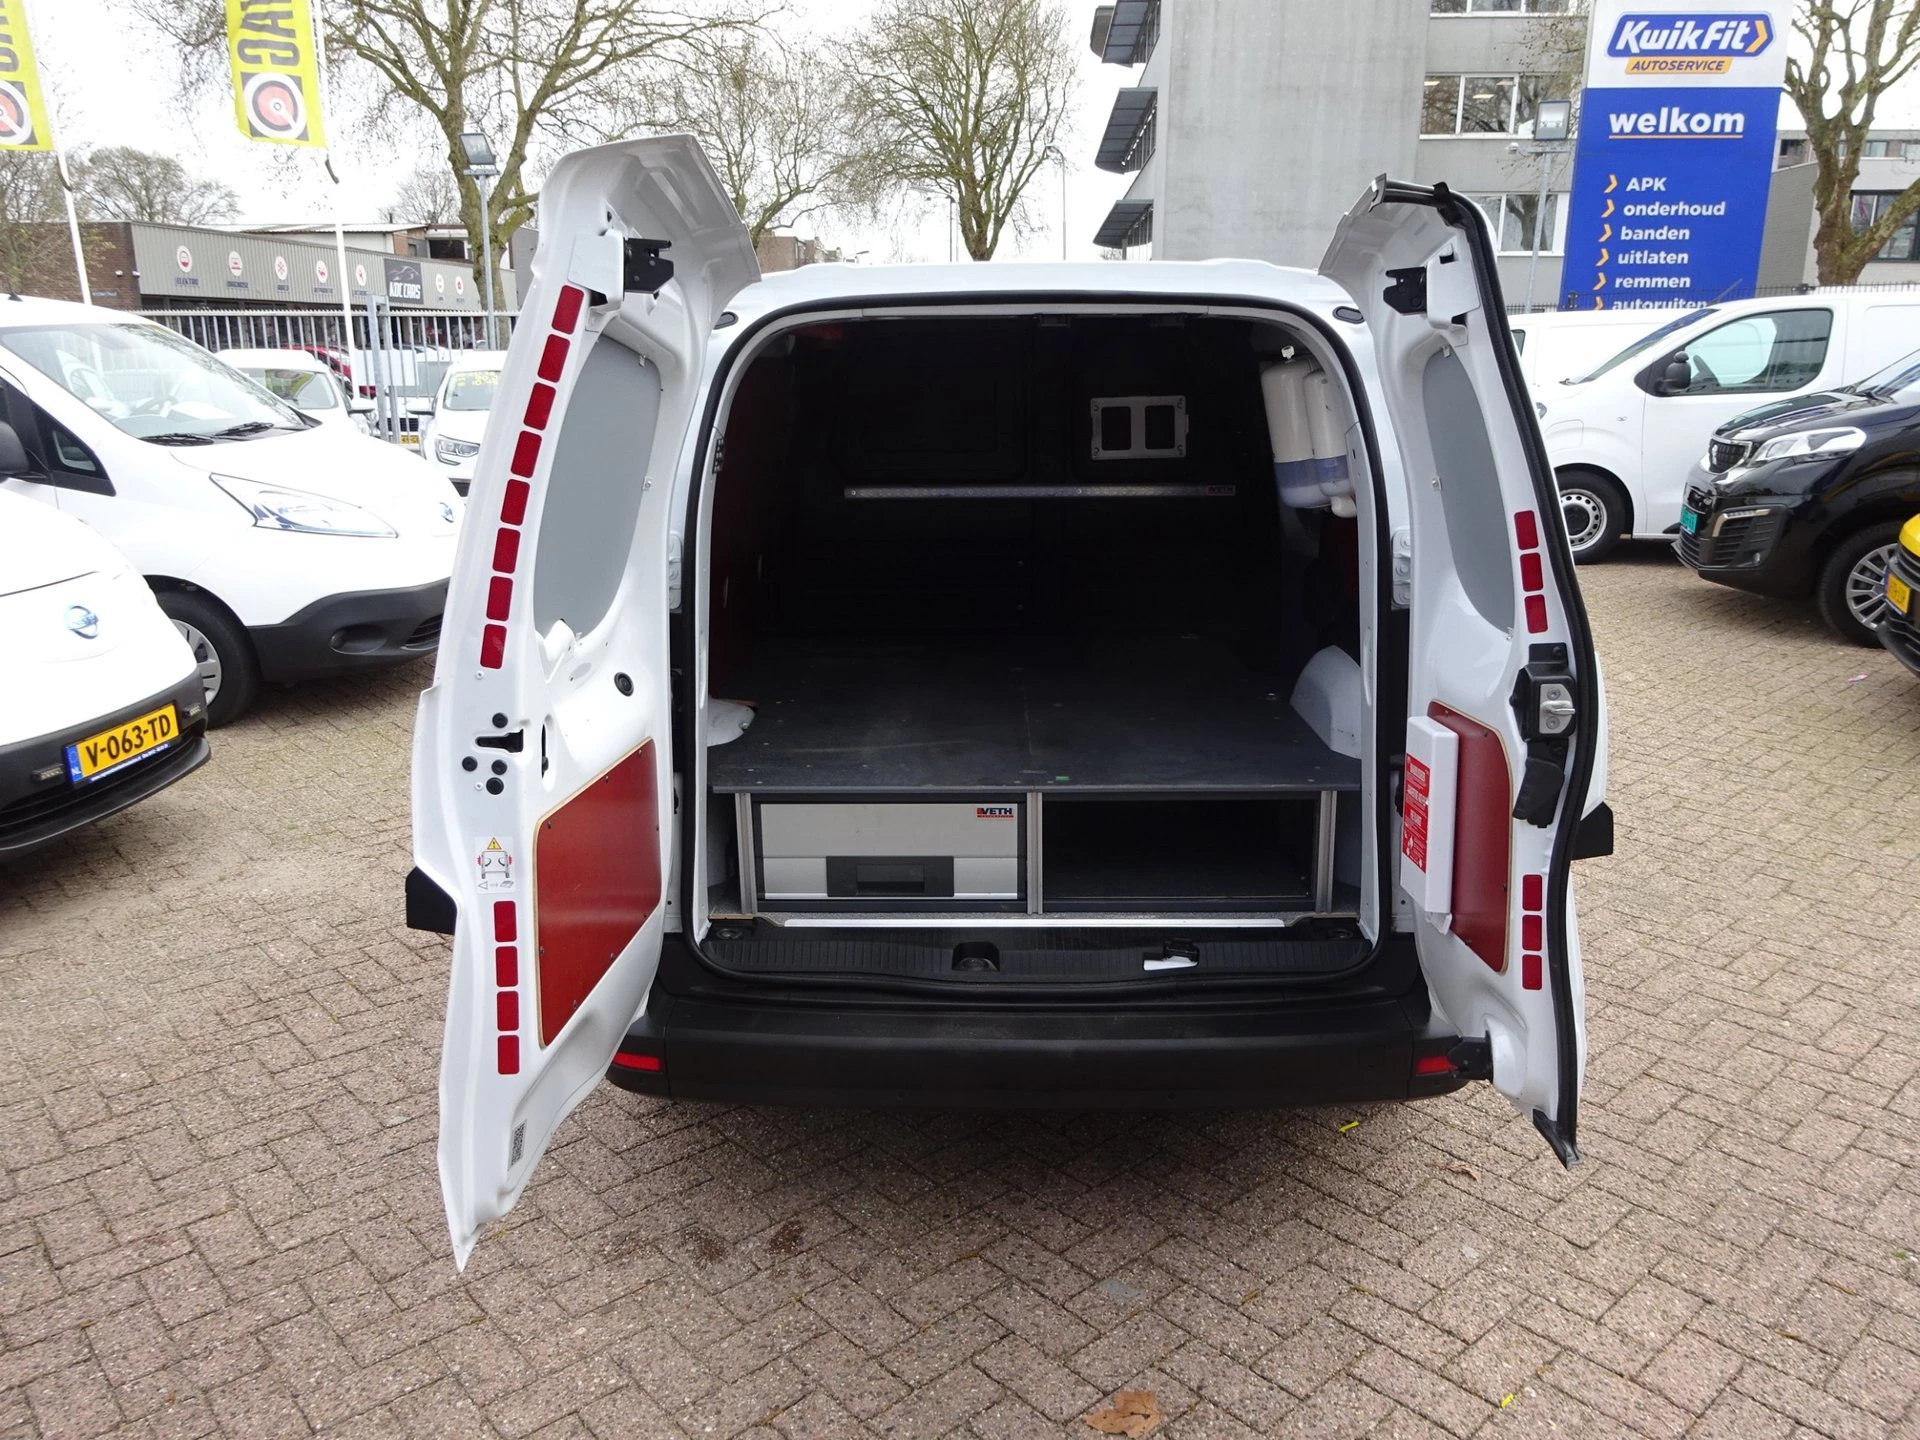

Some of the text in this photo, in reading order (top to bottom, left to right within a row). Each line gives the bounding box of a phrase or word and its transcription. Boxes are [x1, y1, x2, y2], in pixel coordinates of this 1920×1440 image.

[1631, 60, 1725, 71] AUTOSERVICE
[1609, 107, 1745, 133] welkom
[1626, 177, 1667, 192] APK
[1623, 201, 1726, 216] onderhoud
[1620, 226, 1690, 240] banden
[1617, 250, 1689, 265] uitlaten
[1614, 276, 1691, 288] remmen
[1612, 298, 1707, 310] autoruiten
[85, 714, 171, 768] V-063-TD
[980, 807, 1012, 815] VETH
